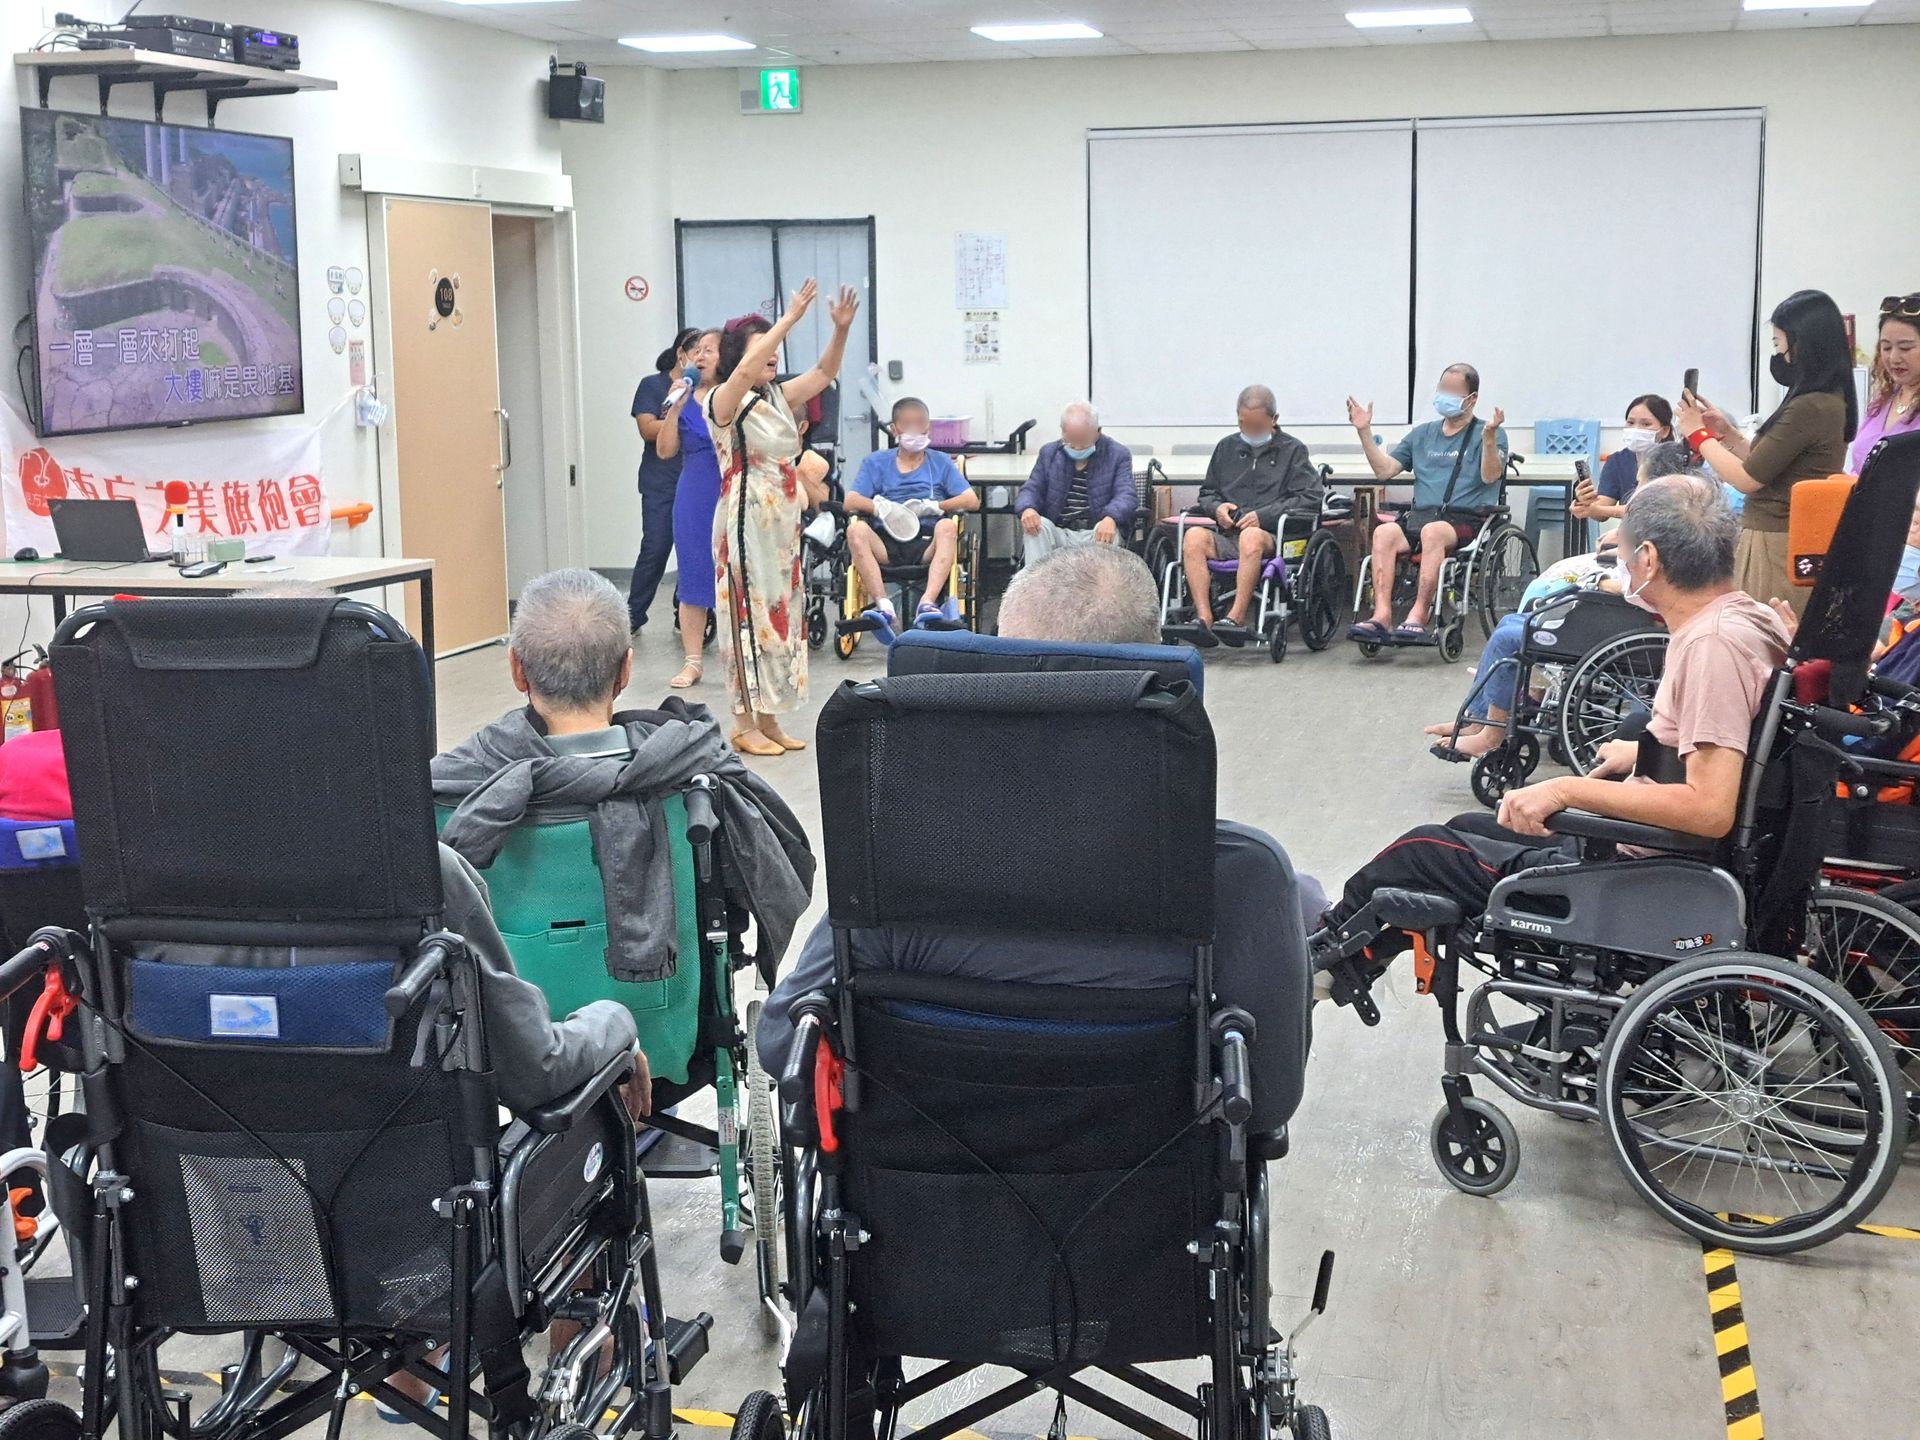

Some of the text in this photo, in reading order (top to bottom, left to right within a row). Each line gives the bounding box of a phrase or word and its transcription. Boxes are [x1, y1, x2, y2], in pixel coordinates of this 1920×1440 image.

[49, 327, 200, 365] 一層一層來打起
